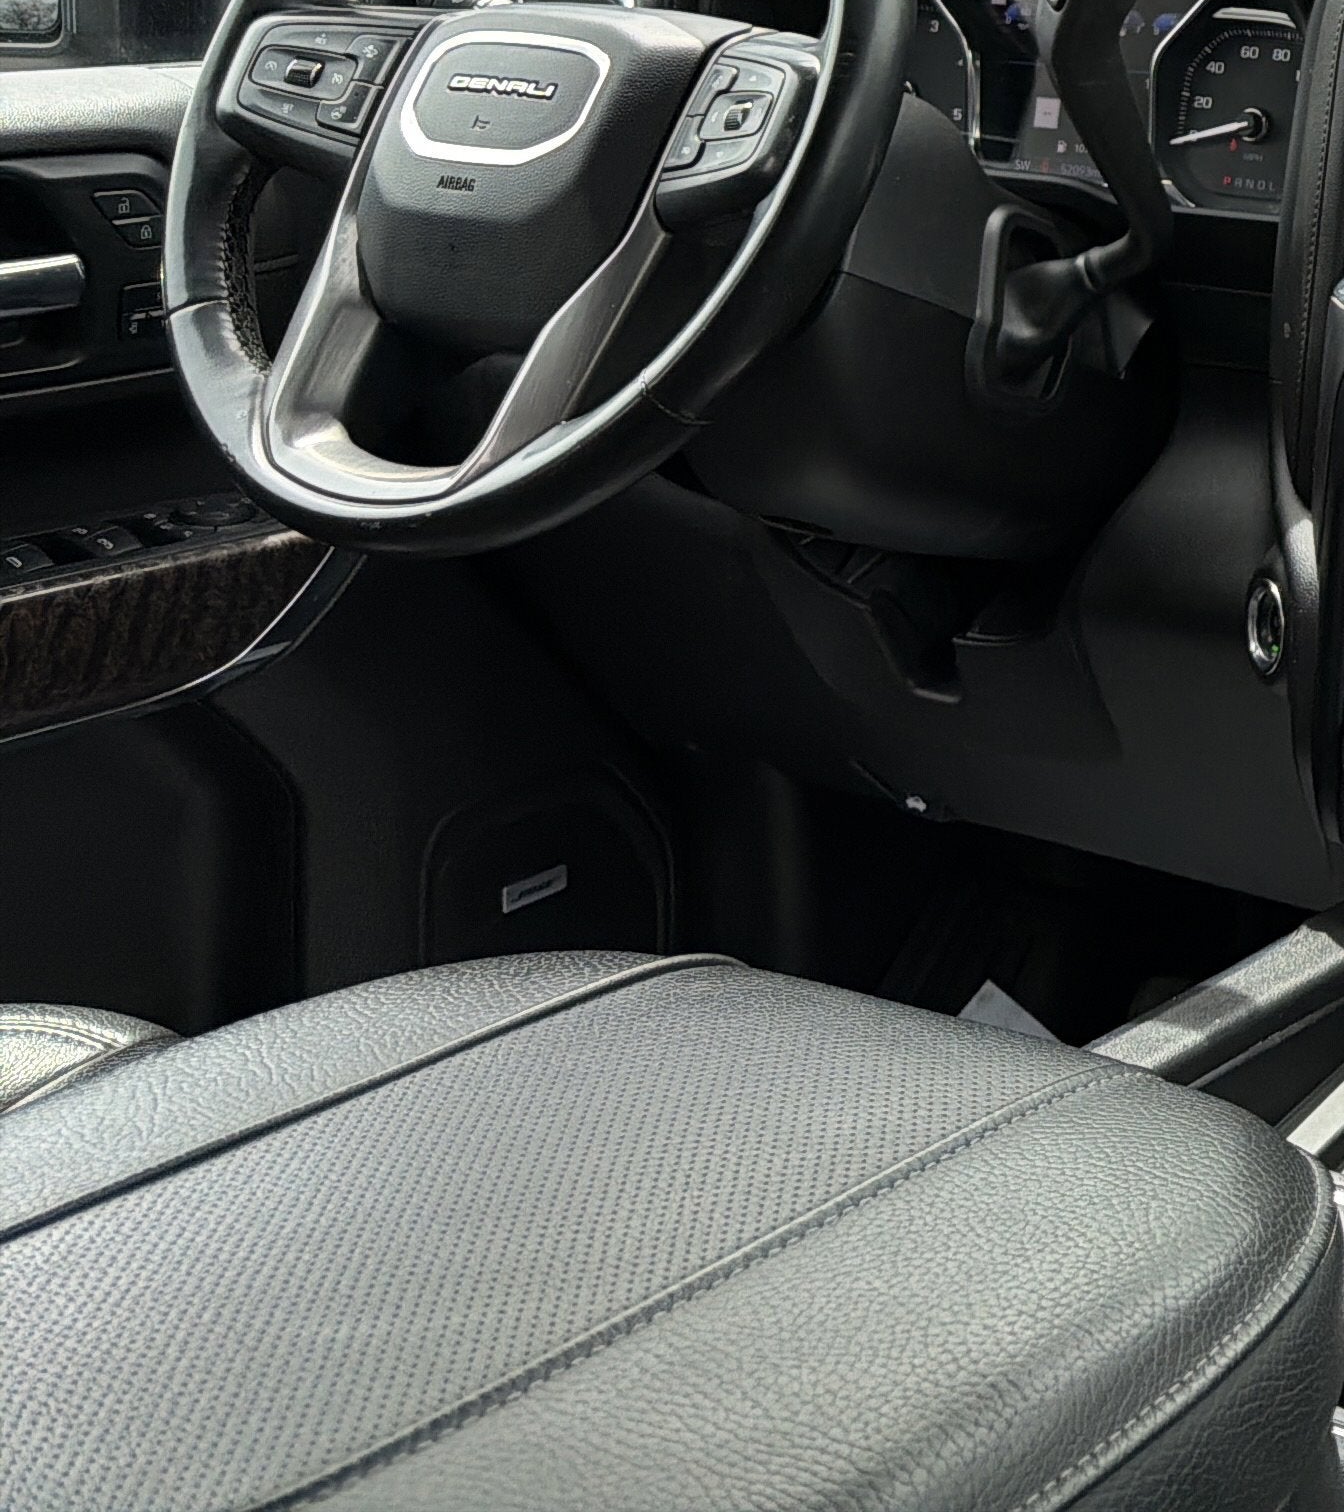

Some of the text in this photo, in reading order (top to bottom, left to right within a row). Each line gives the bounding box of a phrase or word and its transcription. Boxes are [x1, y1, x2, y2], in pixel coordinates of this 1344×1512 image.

[929, 20, 940, 33] 3
[1240, 46, 1260, 60] 60
[1272, 48, 1291, 62] 80
[1205, 61, 1225, 74] 40
[449, 74, 557, 99] DENALI
[1193, 96, 1213, 109] 20
[952, 108, 963, 121] 5
[436, 175, 477, 192] AIRBAG
